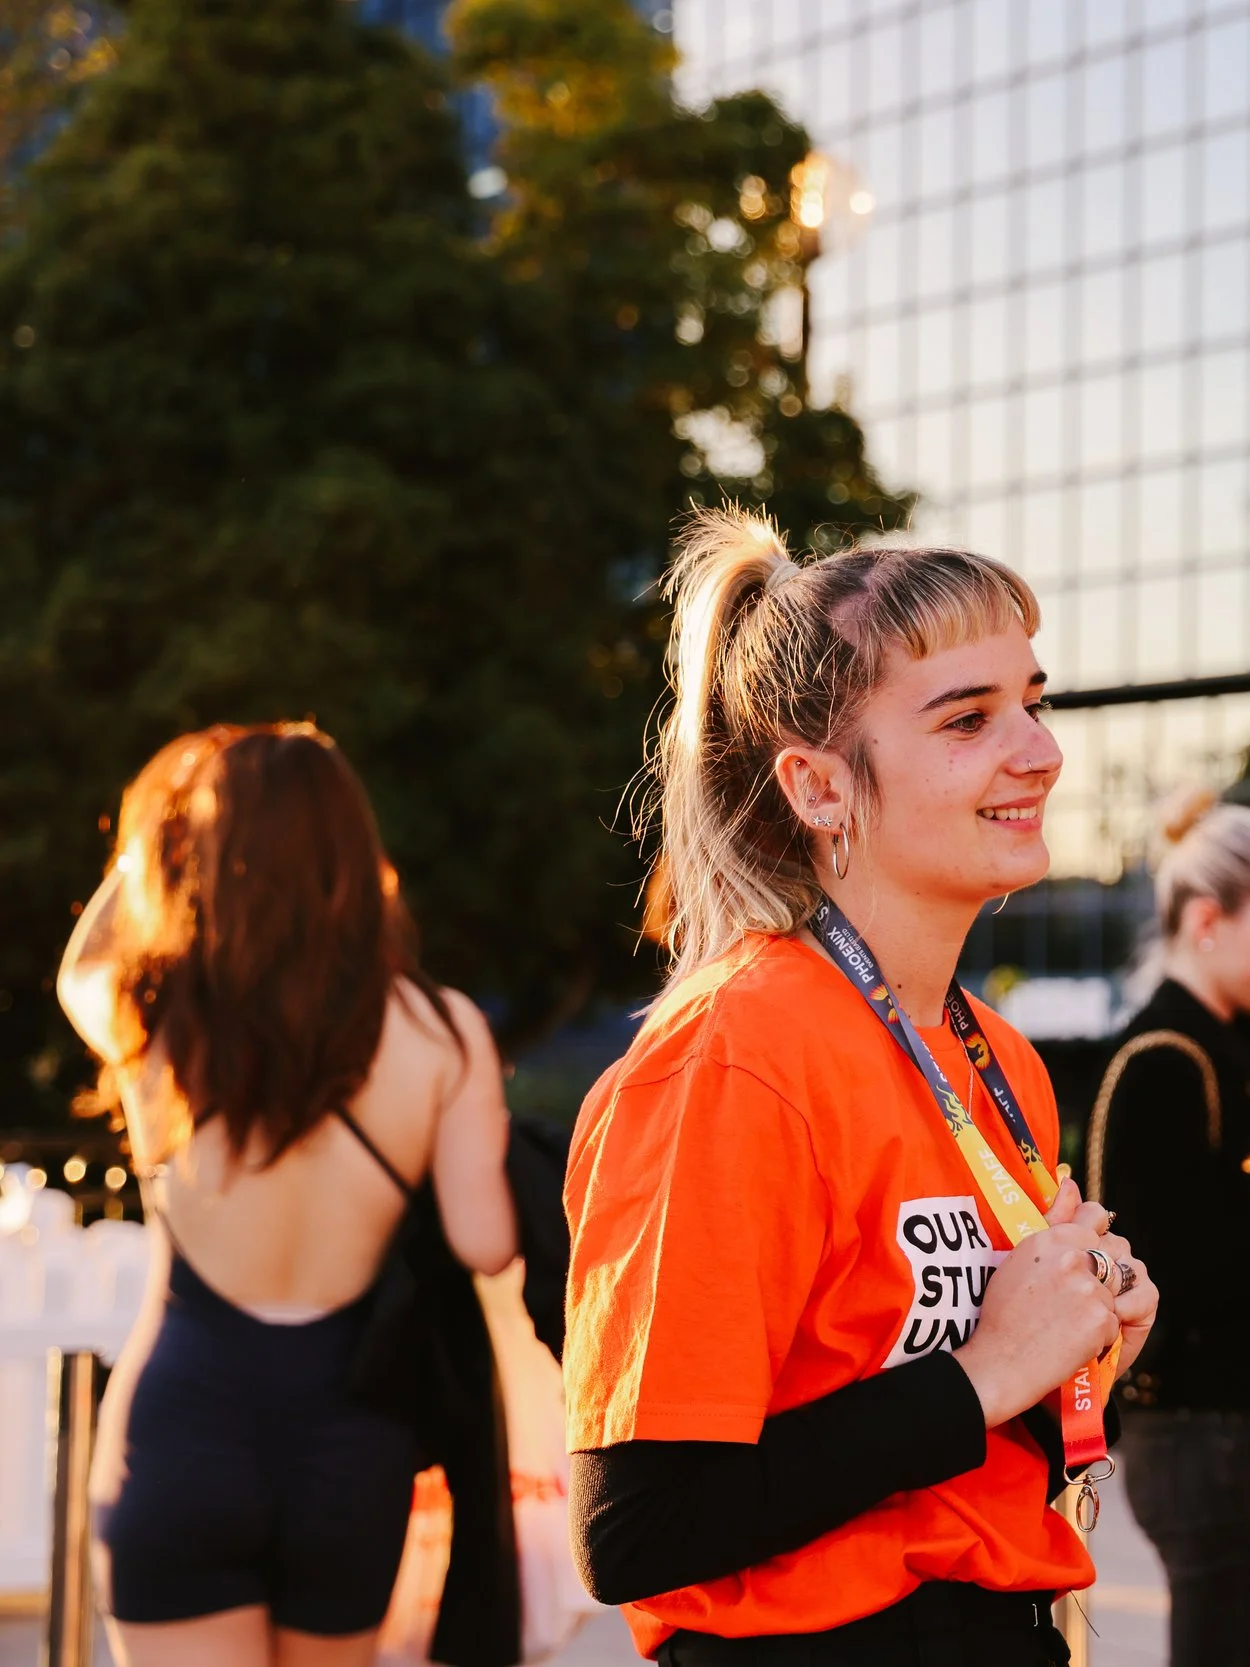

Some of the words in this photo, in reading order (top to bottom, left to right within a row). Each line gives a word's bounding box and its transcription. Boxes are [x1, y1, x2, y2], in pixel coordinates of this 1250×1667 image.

[828, 926, 874, 984] PHOENIX
[858, 950, 874, 968] EVENTS
[978, 1148, 1020, 1205] STAFF
[903, 1211, 987, 1254] OUR
[903, 1318, 980, 1354] UN
